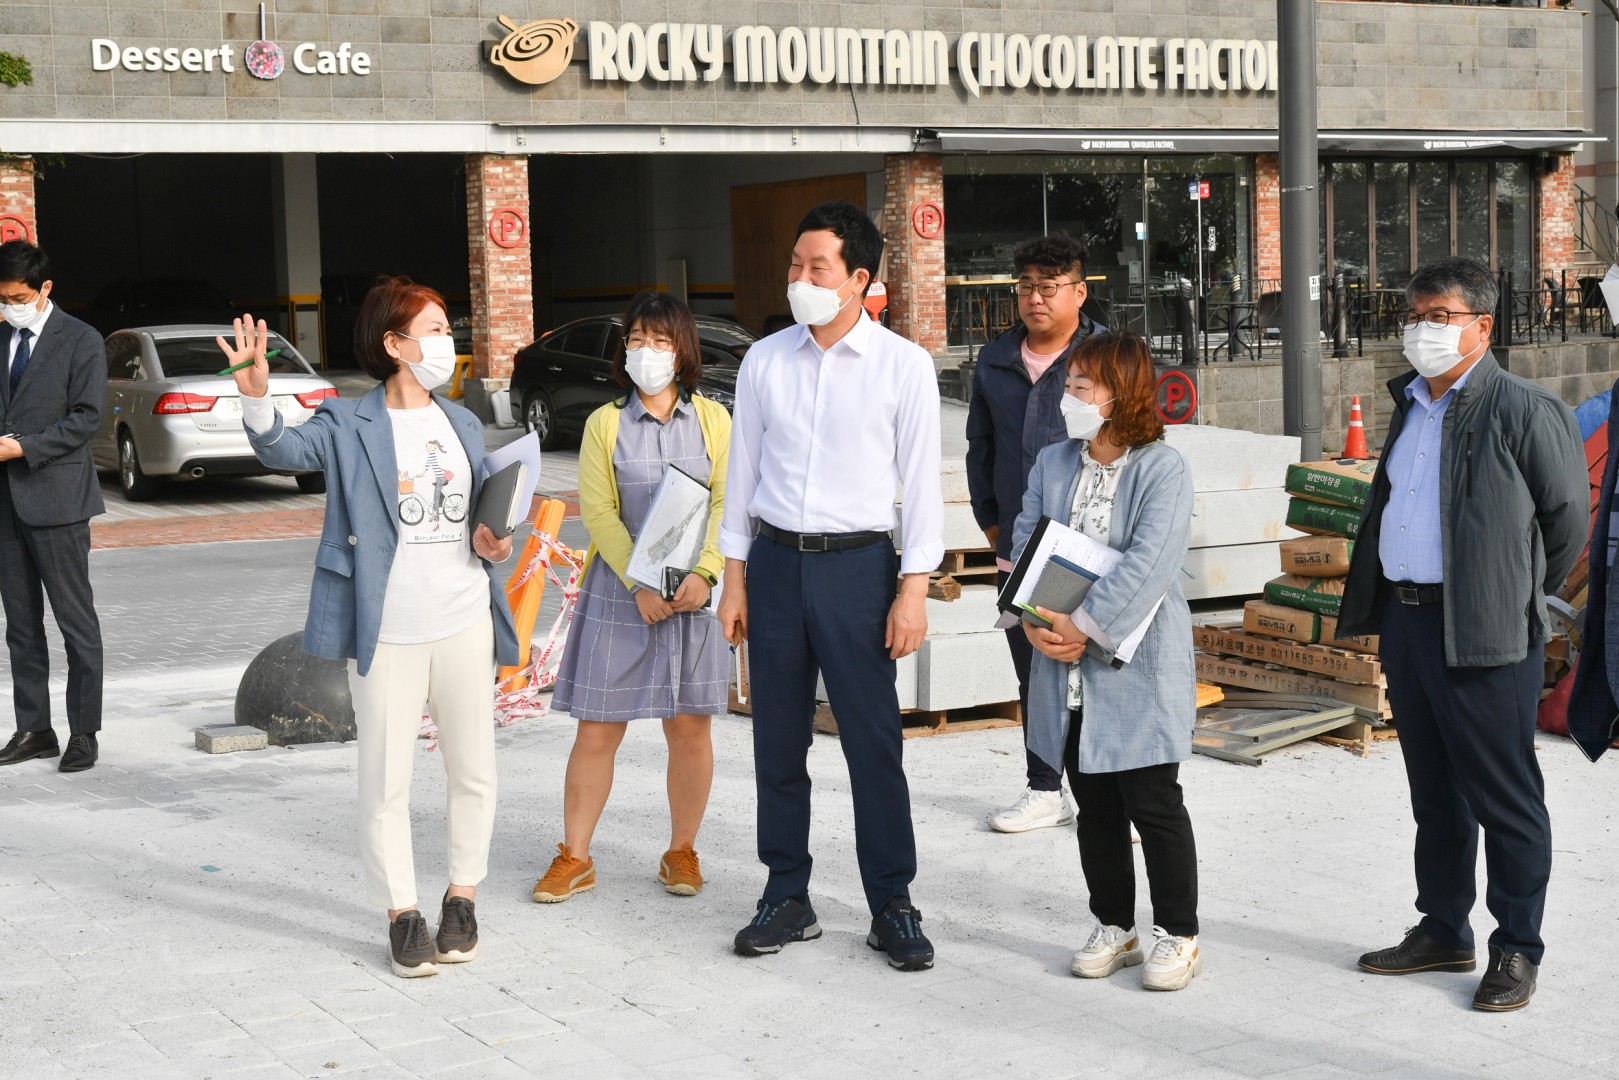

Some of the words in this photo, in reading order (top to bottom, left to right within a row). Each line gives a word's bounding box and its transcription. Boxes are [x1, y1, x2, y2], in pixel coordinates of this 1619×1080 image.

[91, 38, 235, 73] Dessert
[293, 42, 371, 74] Cafe
[588, 20, 724, 82] ROCKY
[732, 25, 950, 85] MOUNTAIN
[957, 31, 1159, 99] CHOCOLATE
[501, 217, 517, 242] P
[922, 210, 937, 233] P
[1166, 382, 1186, 413] P
[1306, 472, 1341, 488] 일반미장용
[414, 534, 440, 542] Bonjour
